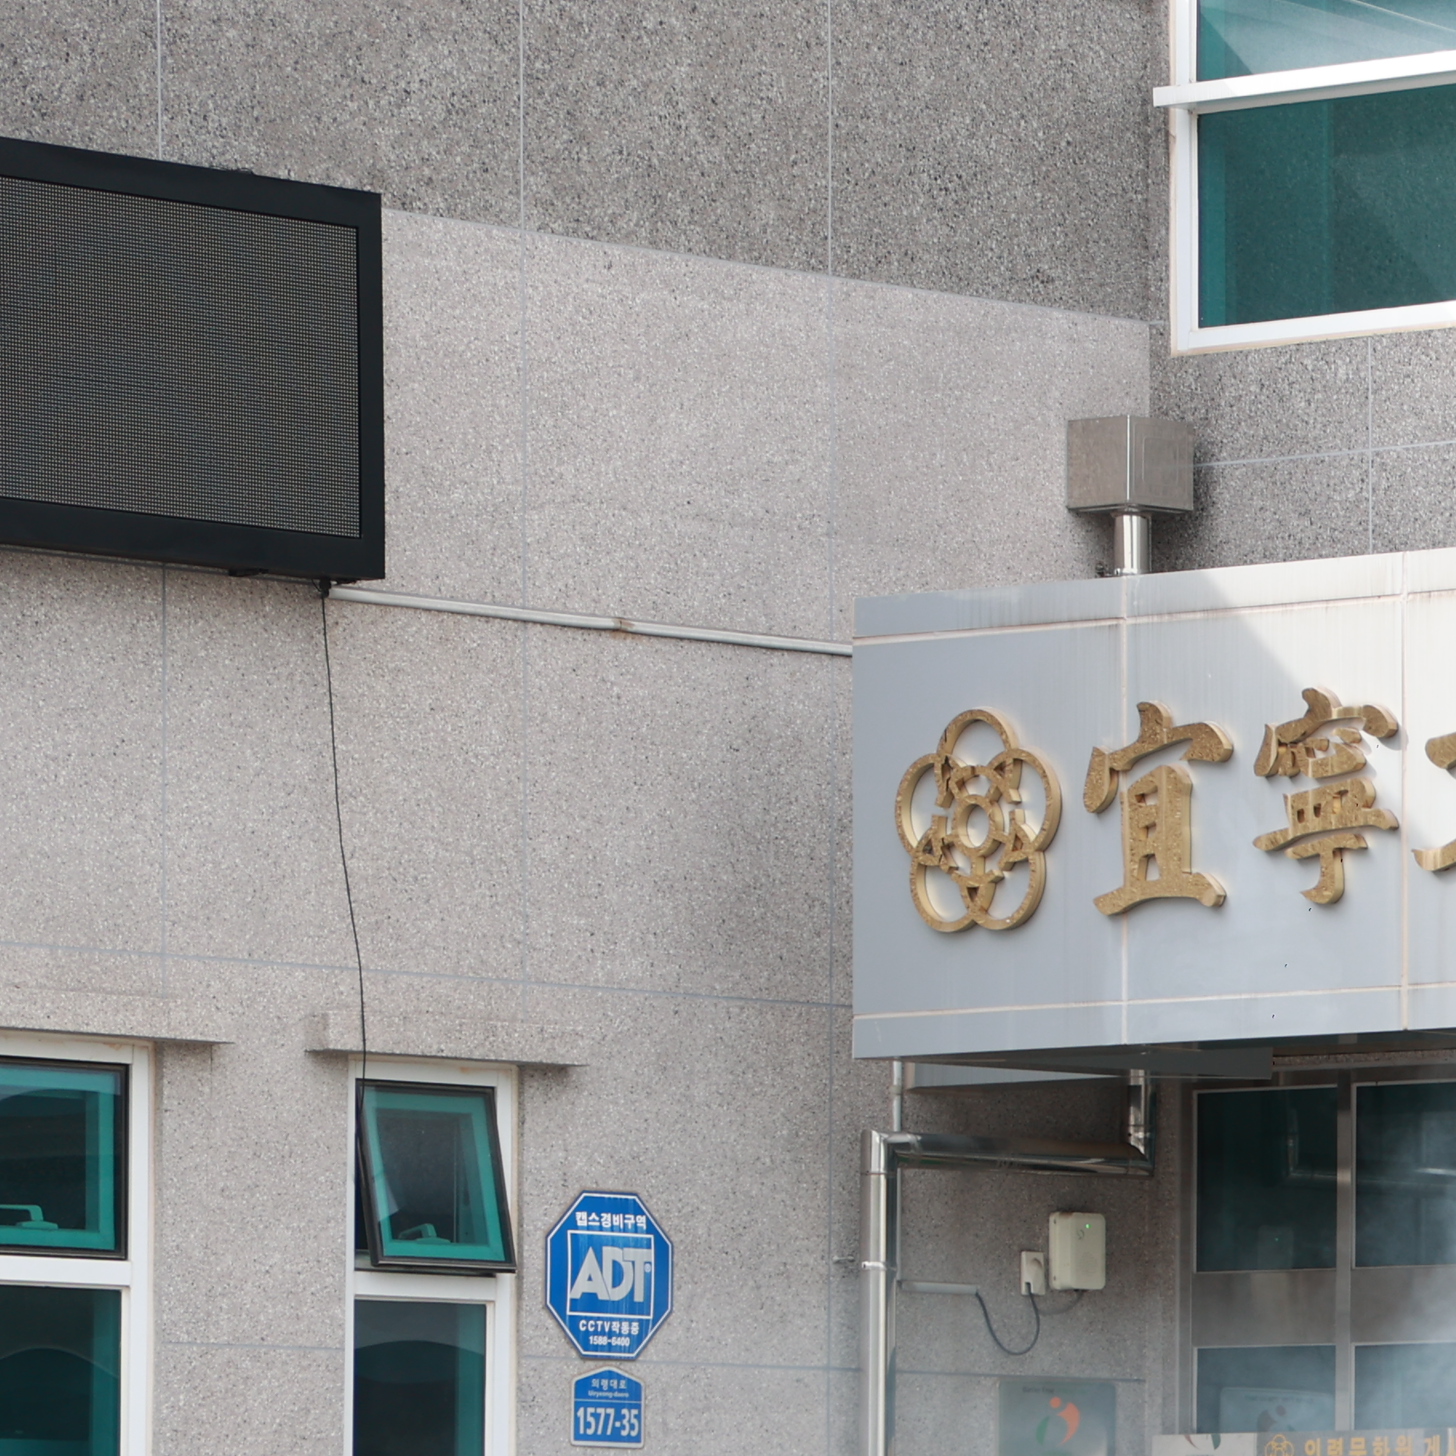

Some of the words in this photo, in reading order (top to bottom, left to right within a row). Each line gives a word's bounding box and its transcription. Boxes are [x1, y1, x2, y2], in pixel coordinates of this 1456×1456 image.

[575, 1211, 647, 1230] 캡스경비구역
[569, 1246, 652, 1302] ADT
[579, 1319, 640, 1335] CCTV작동중
[589, 1335, 630, 1347] 1588-6400
[591, 1378, 627, 1391] 의령대로
[576, 1406, 639, 1437] 1577-35
